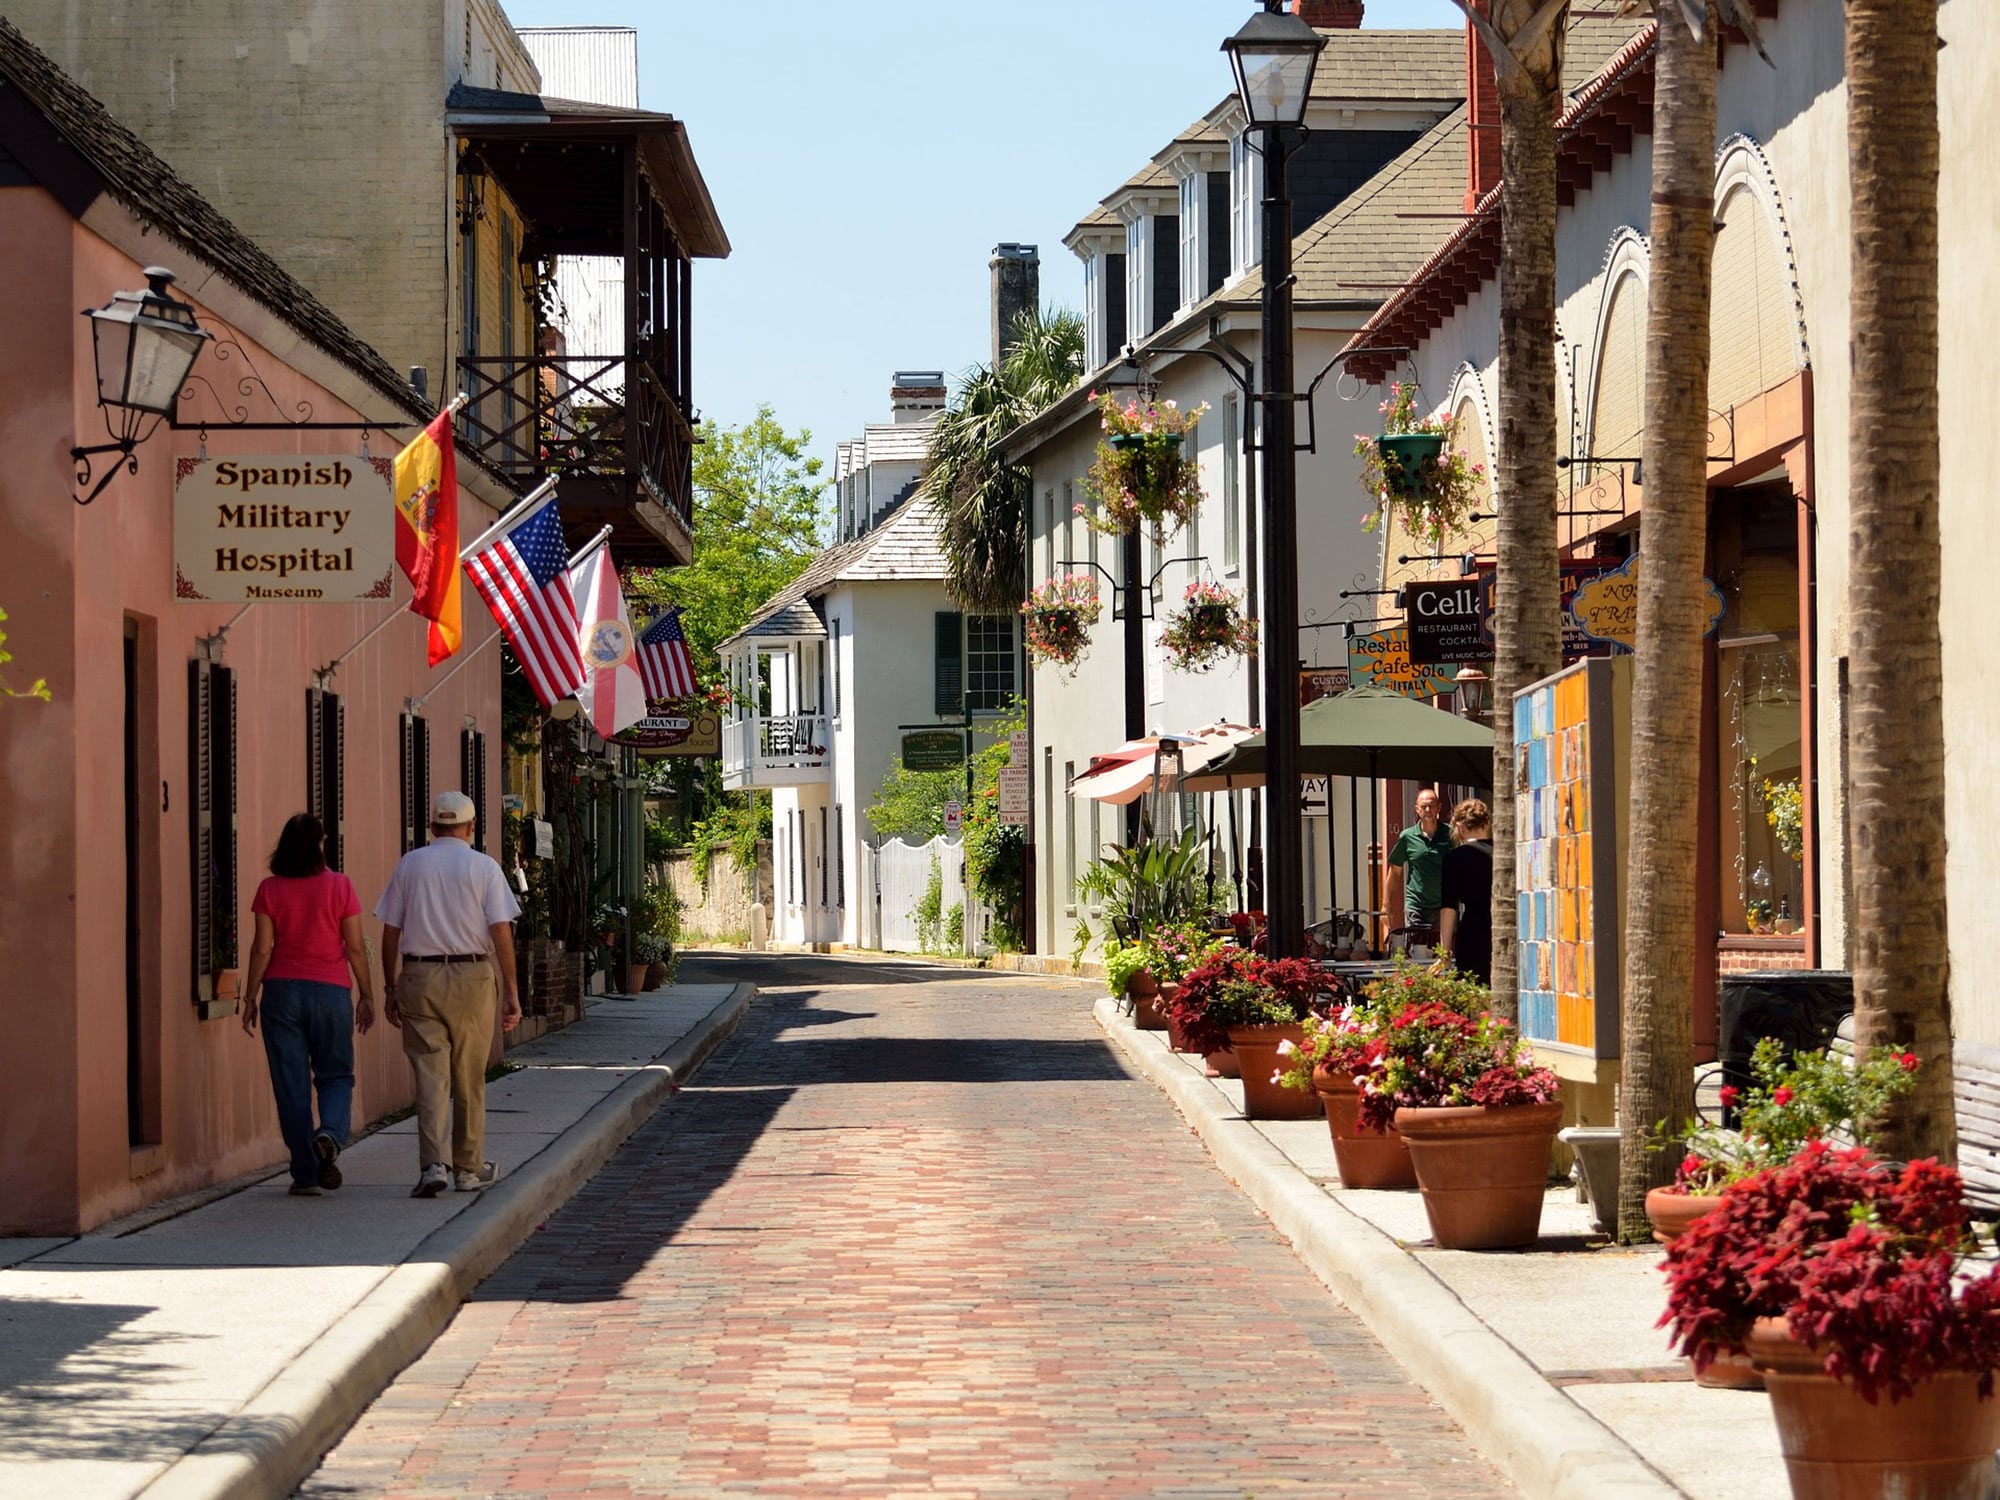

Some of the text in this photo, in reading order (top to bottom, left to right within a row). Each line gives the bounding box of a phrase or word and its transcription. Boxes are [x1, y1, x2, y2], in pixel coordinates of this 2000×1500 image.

[215, 461, 353, 492] Spanish
[217, 503, 351, 534] Military
[215, 547, 353, 577] Hospital
[246, 586, 323, 598] Museum
[1417, 623, 1478, 633] RESTAURANT
[1439, 637, 1484, 646] COCKTAI
[1301, 779, 1327, 792] AY
